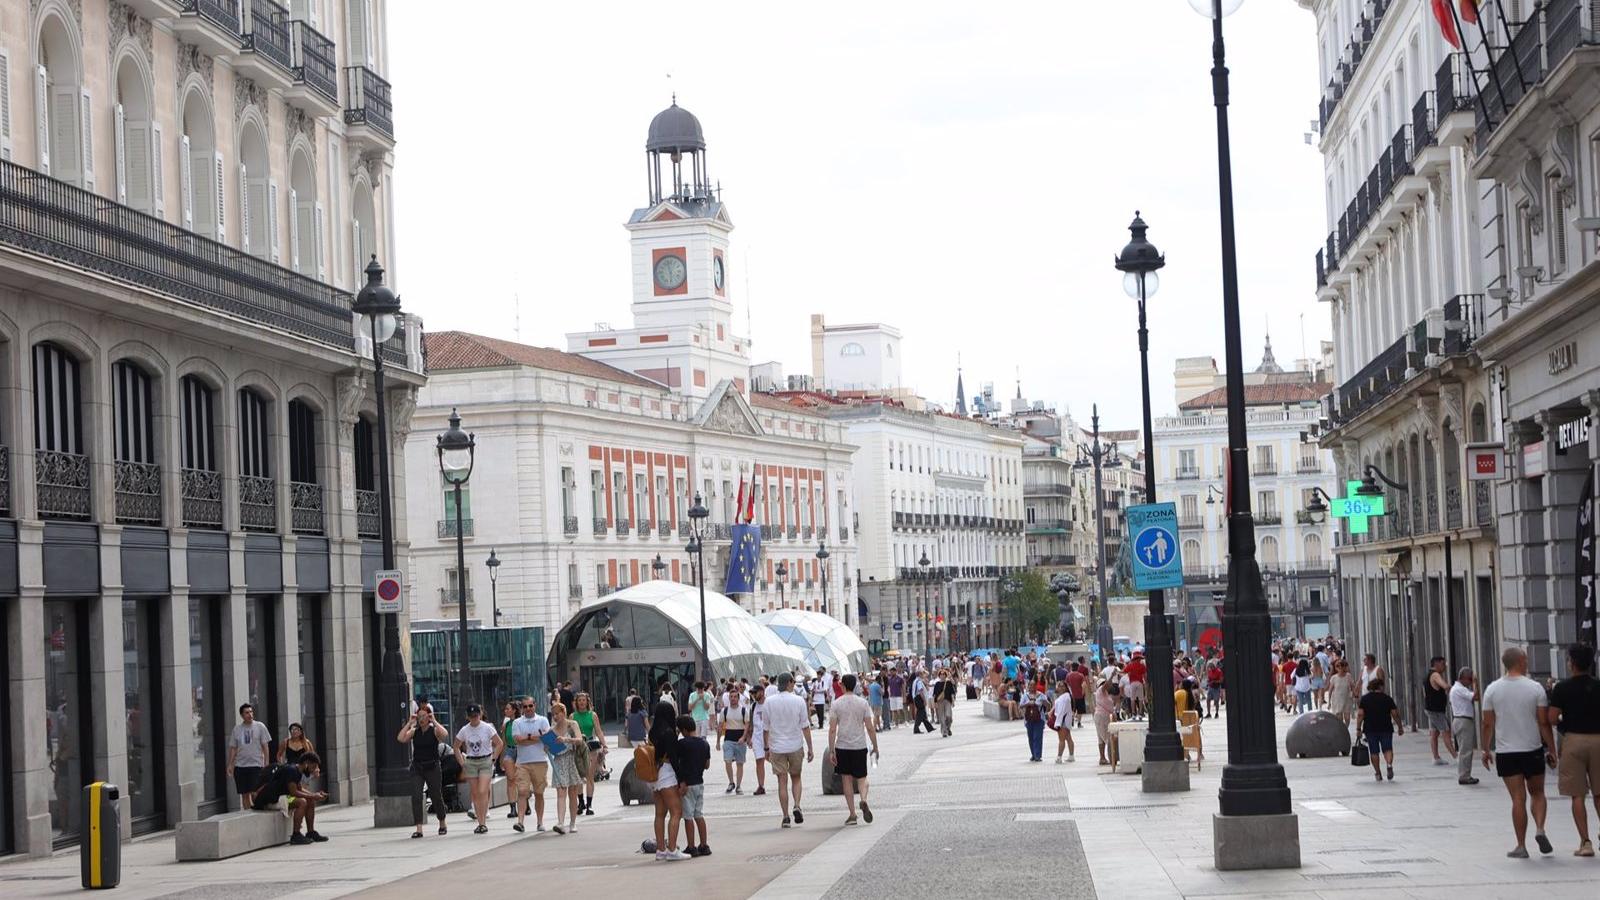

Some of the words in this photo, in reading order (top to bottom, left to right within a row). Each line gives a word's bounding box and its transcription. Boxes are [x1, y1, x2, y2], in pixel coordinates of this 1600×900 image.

[1559, 416, 1589, 449] DECIMAS
[1146, 510, 1175, 518] ZONA
[1344, 500, 1371, 514] 365
